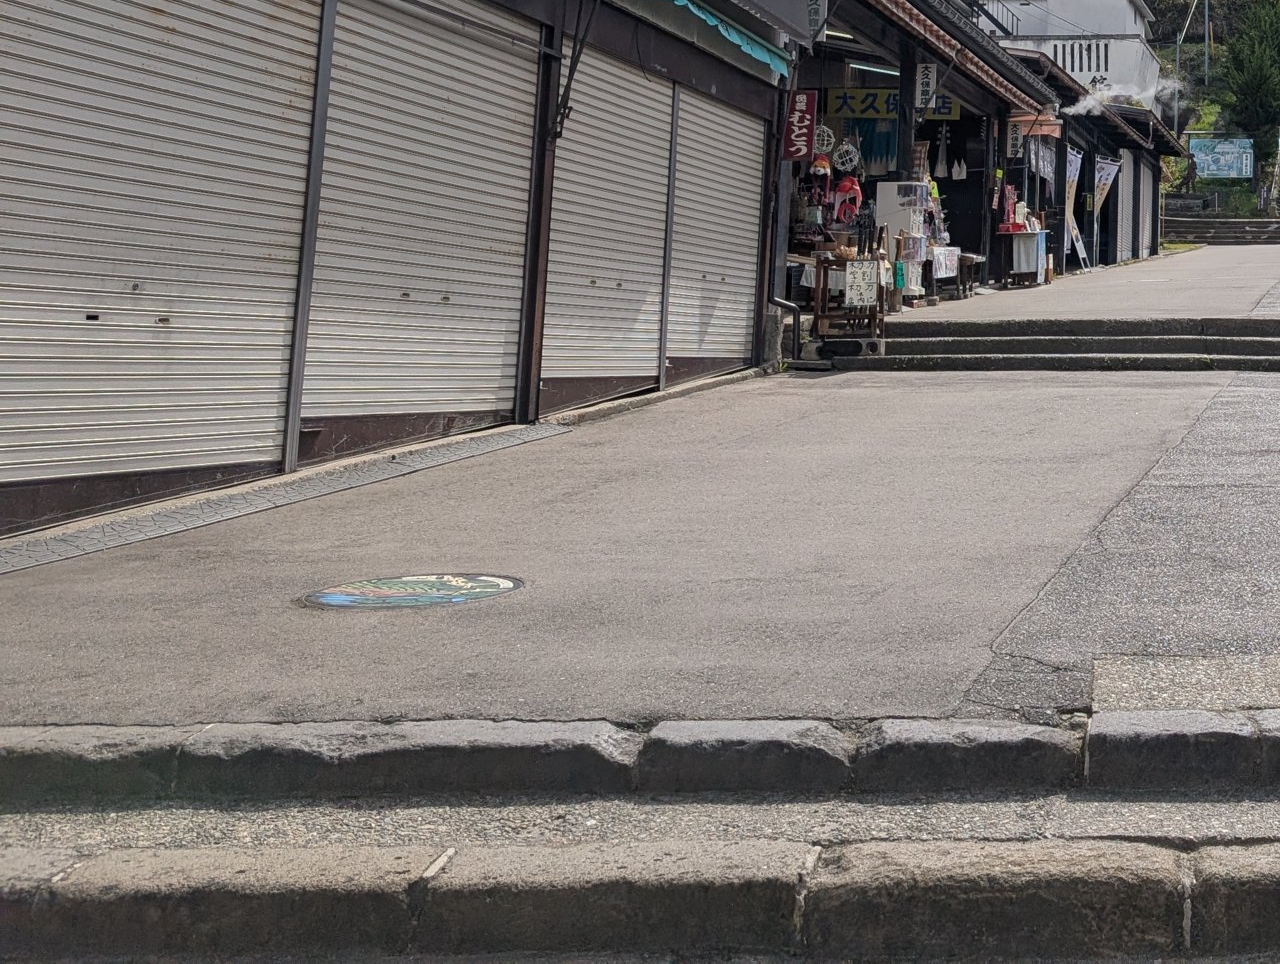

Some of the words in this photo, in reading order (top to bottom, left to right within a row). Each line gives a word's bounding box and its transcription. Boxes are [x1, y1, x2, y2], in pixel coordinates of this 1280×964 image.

[835, 92, 953, 117] 大久保店
[920, 65, 932, 106] 大久保商店
[788, 111, 812, 157] むとう
